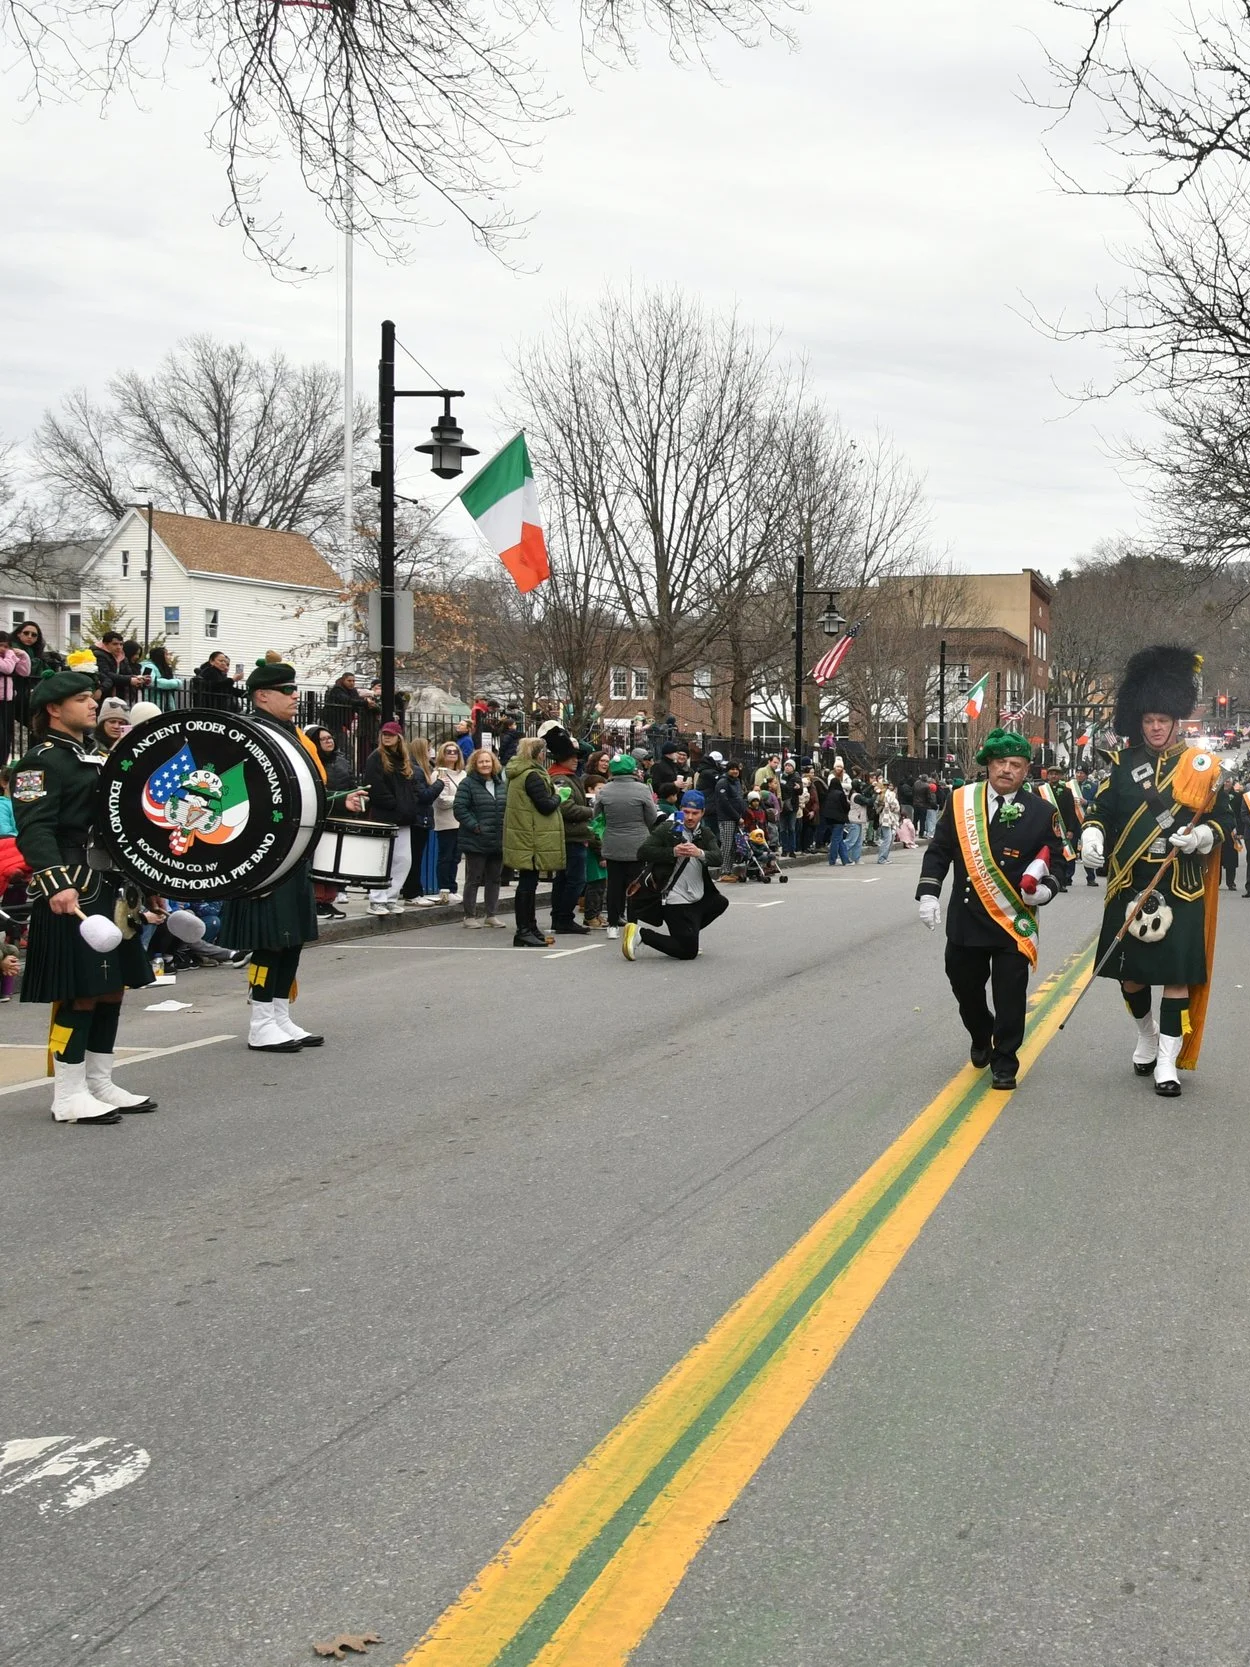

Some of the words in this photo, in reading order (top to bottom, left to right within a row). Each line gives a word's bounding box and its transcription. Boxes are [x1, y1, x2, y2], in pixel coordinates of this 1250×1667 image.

[131, 722, 182, 759] ANCIENT
[185, 720, 226, 735] ORDER
[228, 728, 245, 742] OF
[244, 740, 283, 805] HIBERNIANS
[108, 780, 123, 833] EDWARD
[117, 833, 128, 850] V.
[136, 837, 185, 870] ROCKLAND
[186, 863, 203, 872] CO.
[205, 861, 219, 871] NY
[250, 832, 276, 864] BAND
[965, 808, 978, 845] GRAND
[972, 849, 1001, 899] MARSHAL
[122, 845, 163, 882] LARKIN
[229, 859, 254, 879] PIPE
[163, 873, 230, 890] MEMORIAL
